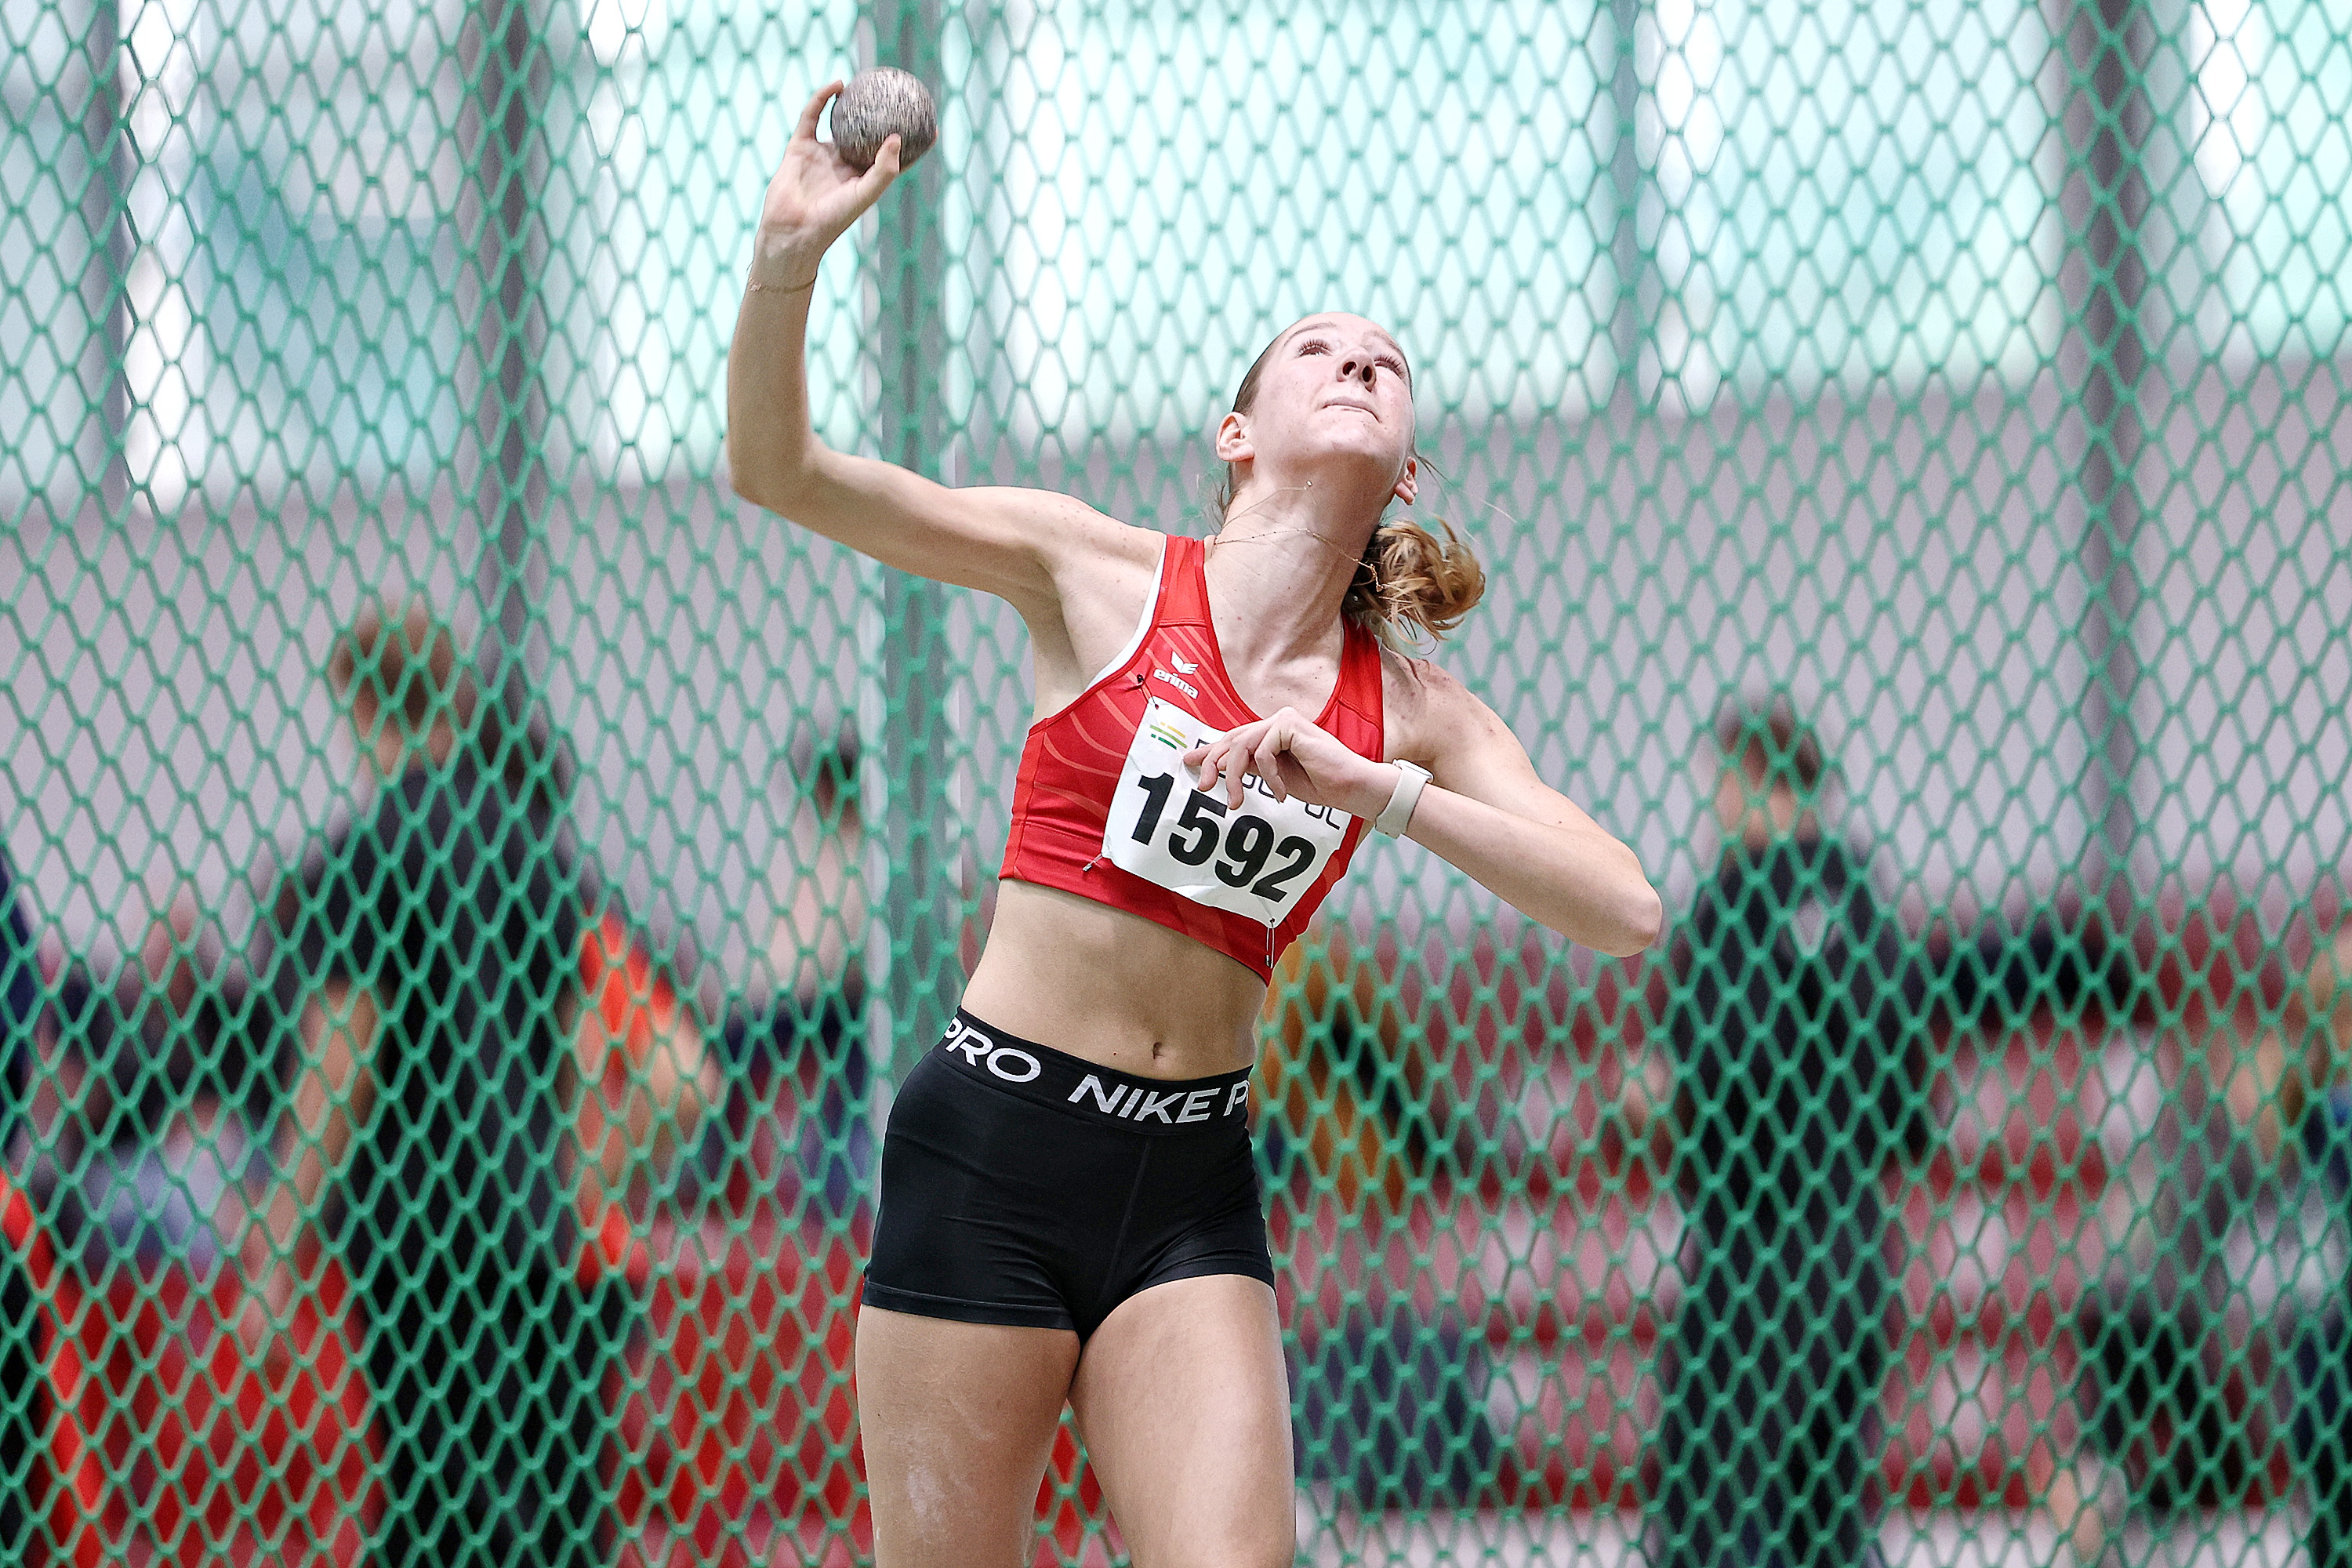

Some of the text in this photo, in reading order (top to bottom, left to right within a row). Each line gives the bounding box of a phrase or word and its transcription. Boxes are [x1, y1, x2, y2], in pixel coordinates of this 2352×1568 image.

[1152, 668, 1200, 700] erima
[1131, 771, 1317, 903] 1592
[943, 1016, 1041, 1083] PRO
[1067, 1073, 1219, 1123] NIKE
